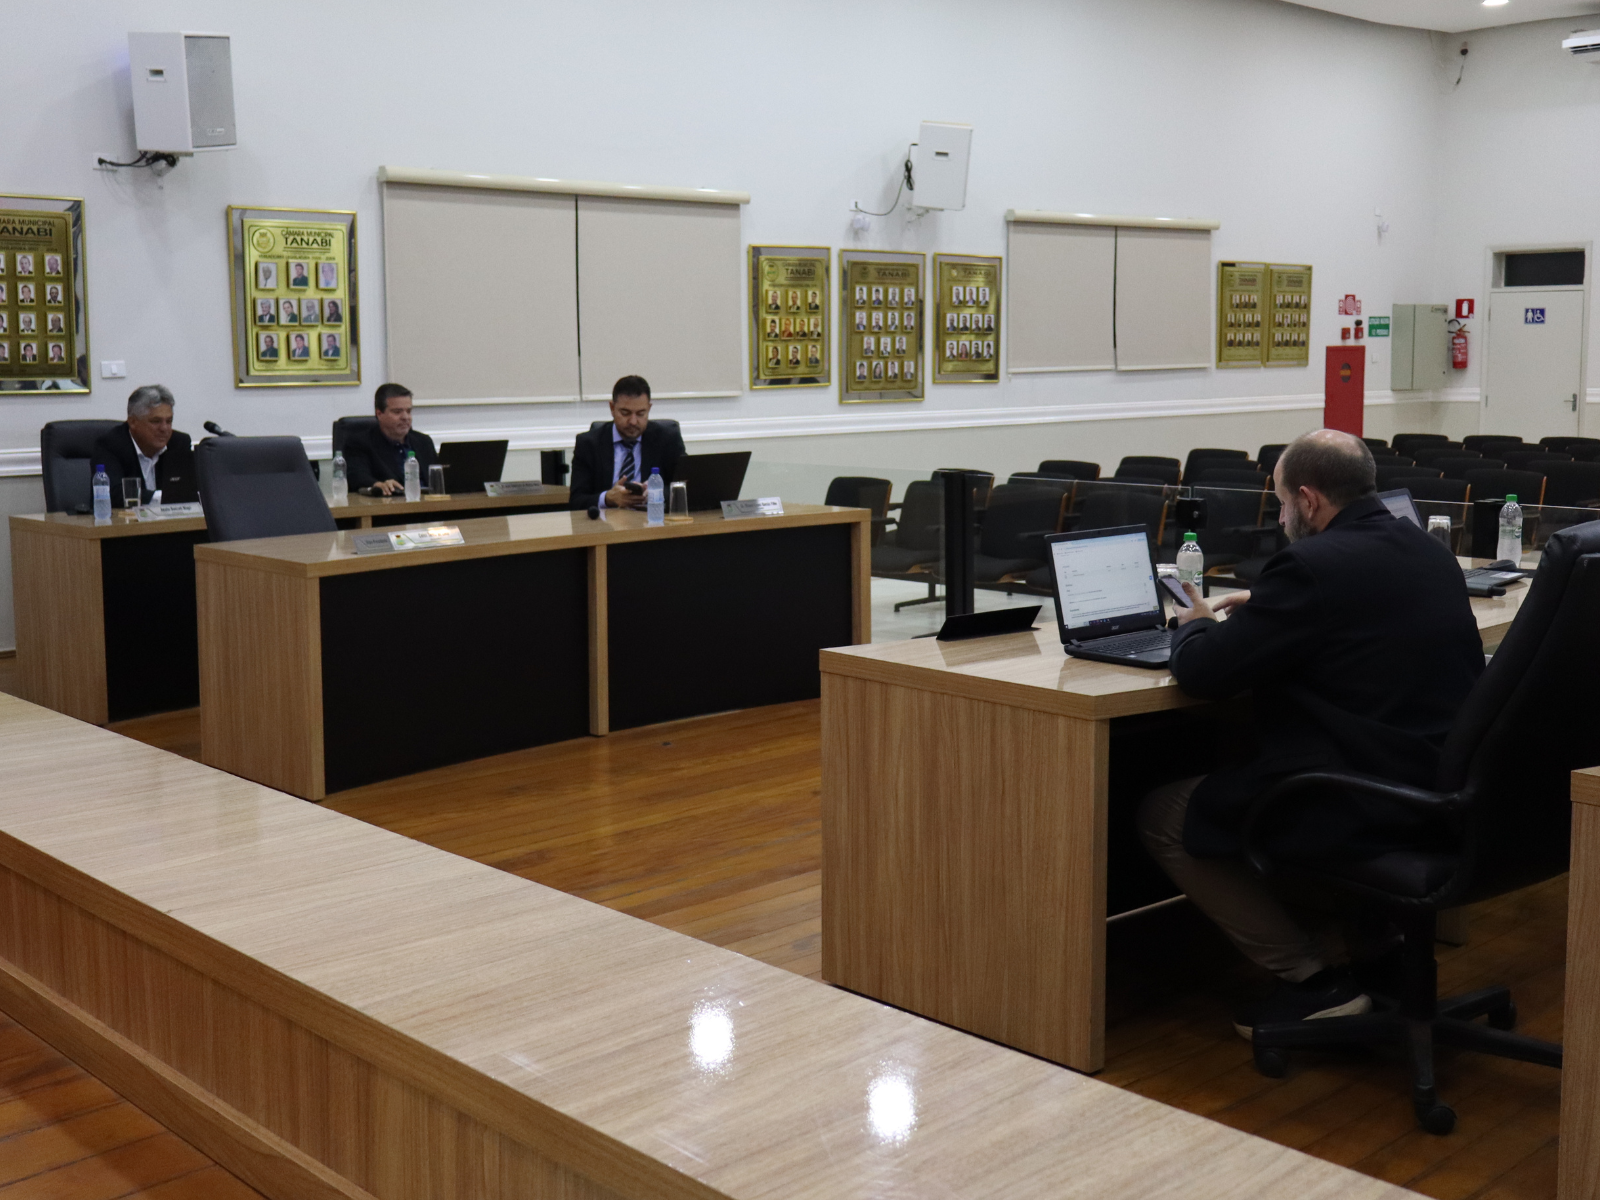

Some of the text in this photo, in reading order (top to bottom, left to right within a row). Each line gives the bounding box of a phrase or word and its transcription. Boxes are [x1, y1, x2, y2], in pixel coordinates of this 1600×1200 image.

[0, 217, 56, 228] ARA MUNICIPAL
[281, 227, 335, 239] CÂMARA MUNICIPAL
[284, 237, 332, 247] TANABI
[785, 268, 815, 277] TANABI
